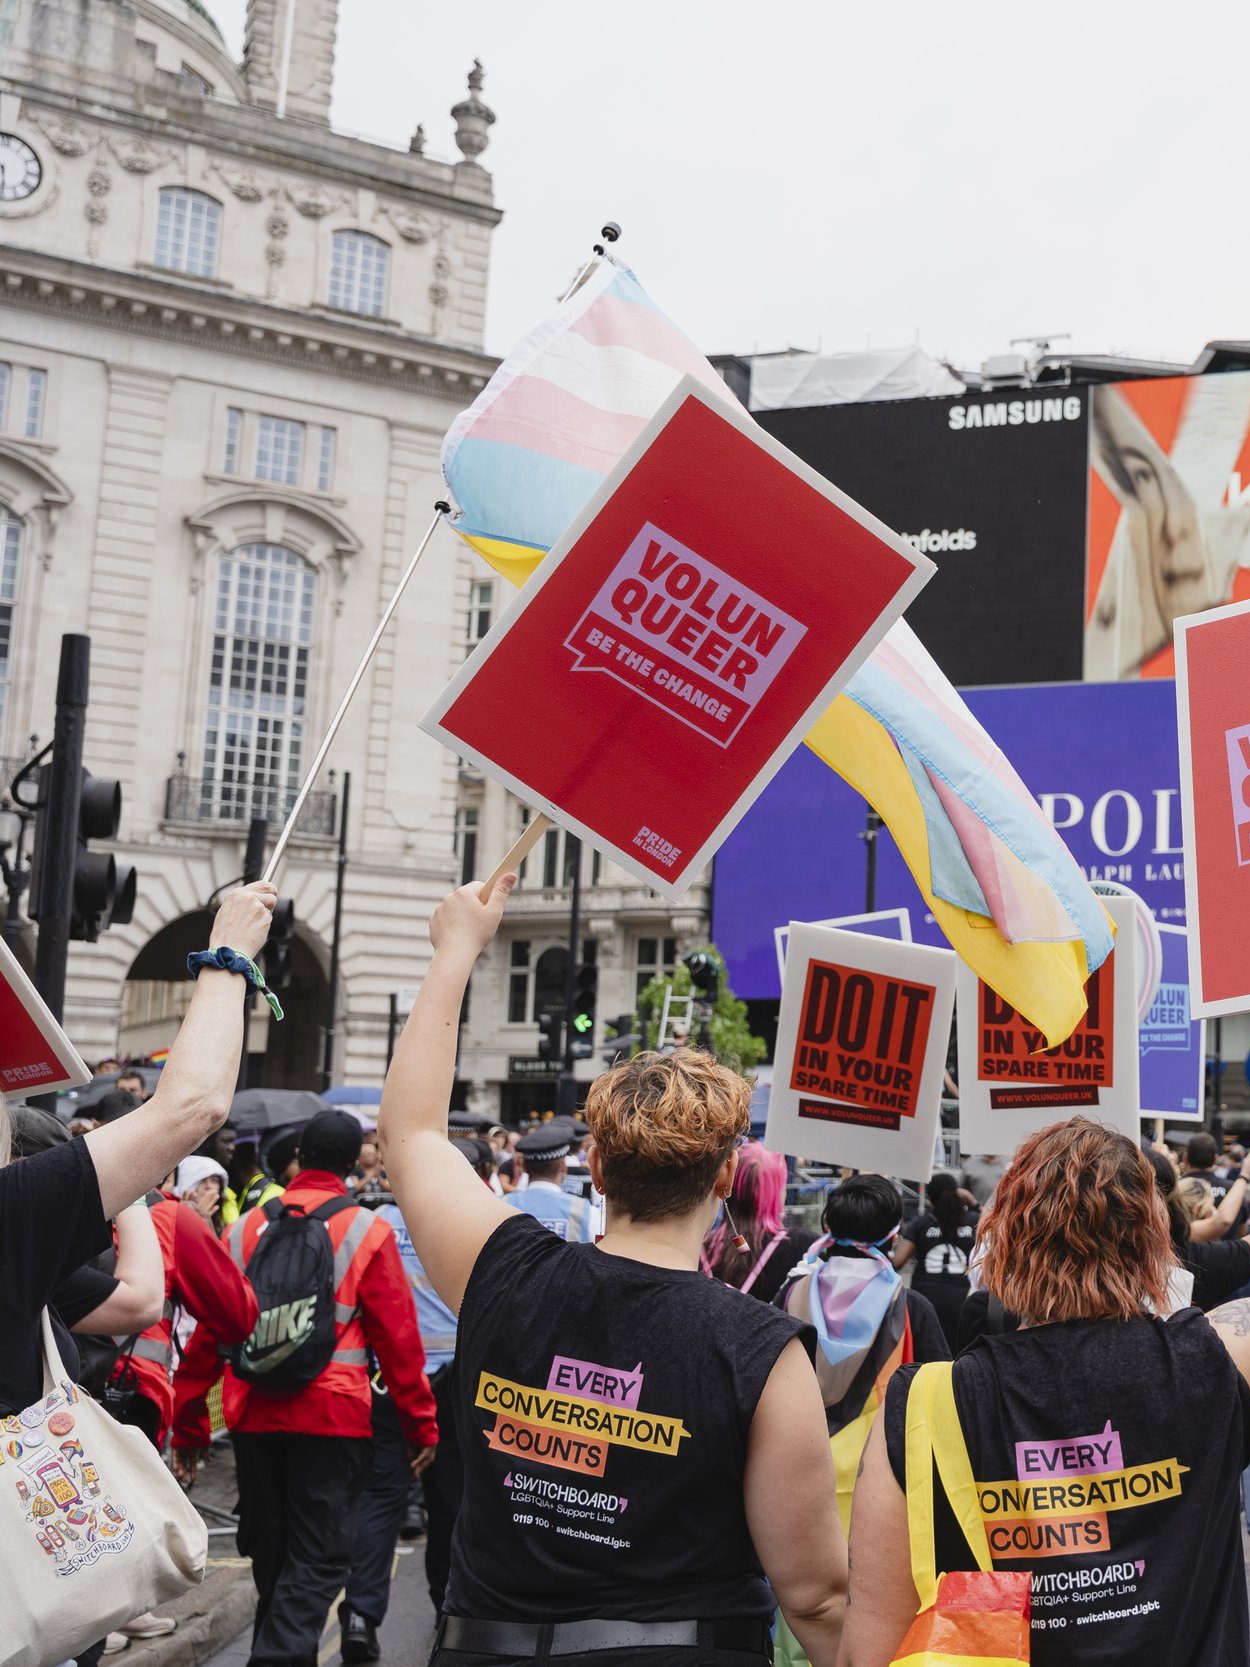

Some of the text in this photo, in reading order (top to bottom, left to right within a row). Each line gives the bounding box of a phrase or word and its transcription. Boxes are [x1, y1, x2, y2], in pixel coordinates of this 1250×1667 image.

[948, 396, 1081, 430] SAMSUNG
[901, 528, 977, 553] nfolds
[638, 538, 786, 658] VOLUN
[611, 578, 759, 693] QUEER
[586, 628, 733, 723] BE THE CHANGE
[1037, 789, 1184, 857] POL
[642, 842, 675, 868] LONDON
[1080, 864, 1132, 881] ALPH
[803, 964, 875, 1053] DO
[875, 982, 931, 1065] IT
[983, 1029, 1014, 1055] IN
[17, 1068, 54, 1081] LONDON
[798, 1045, 913, 1092] IN YOUR
[983, 1058, 1105, 1081] SPARE TIME
[795, 1071, 910, 1111] SPARE TIME
[996, 1091, 1093, 1103] WWW.VOLUNQUEER.UK
[804, 1105, 896, 1125] WWW.VOLUNQUEER.UK
[555, 1364, 637, 1401] EVERY
[483, 1381, 675, 1448] CONVERSATION
[498, 1423, 602, 1468] COUNTS
[1024, 1440, 1113, 1473] EVERY
[514, 1473, 619, 1512] SWITCHBOARD
[977, 1467, 1174, 1514] ONVERSATION
[511, 1491, 615, 1525] LGBTQIA+ Support Line
[512, 1513, 631, 1549] 0119 100 switchboard.lgbt
[990, 1520, 1102, 1551] COUNTS
[71, 1542, 121, 1568] SWITCHBOARD
[1030, 1562, 1135, 1593] WITCHBOARD
[1030, 1583, 1137, 1607] GBTQIA+ Support Line
[1048, 1617, 1067, 1629] 100
[1076, 1600, 1161, 1625] switchboard.lgbt
